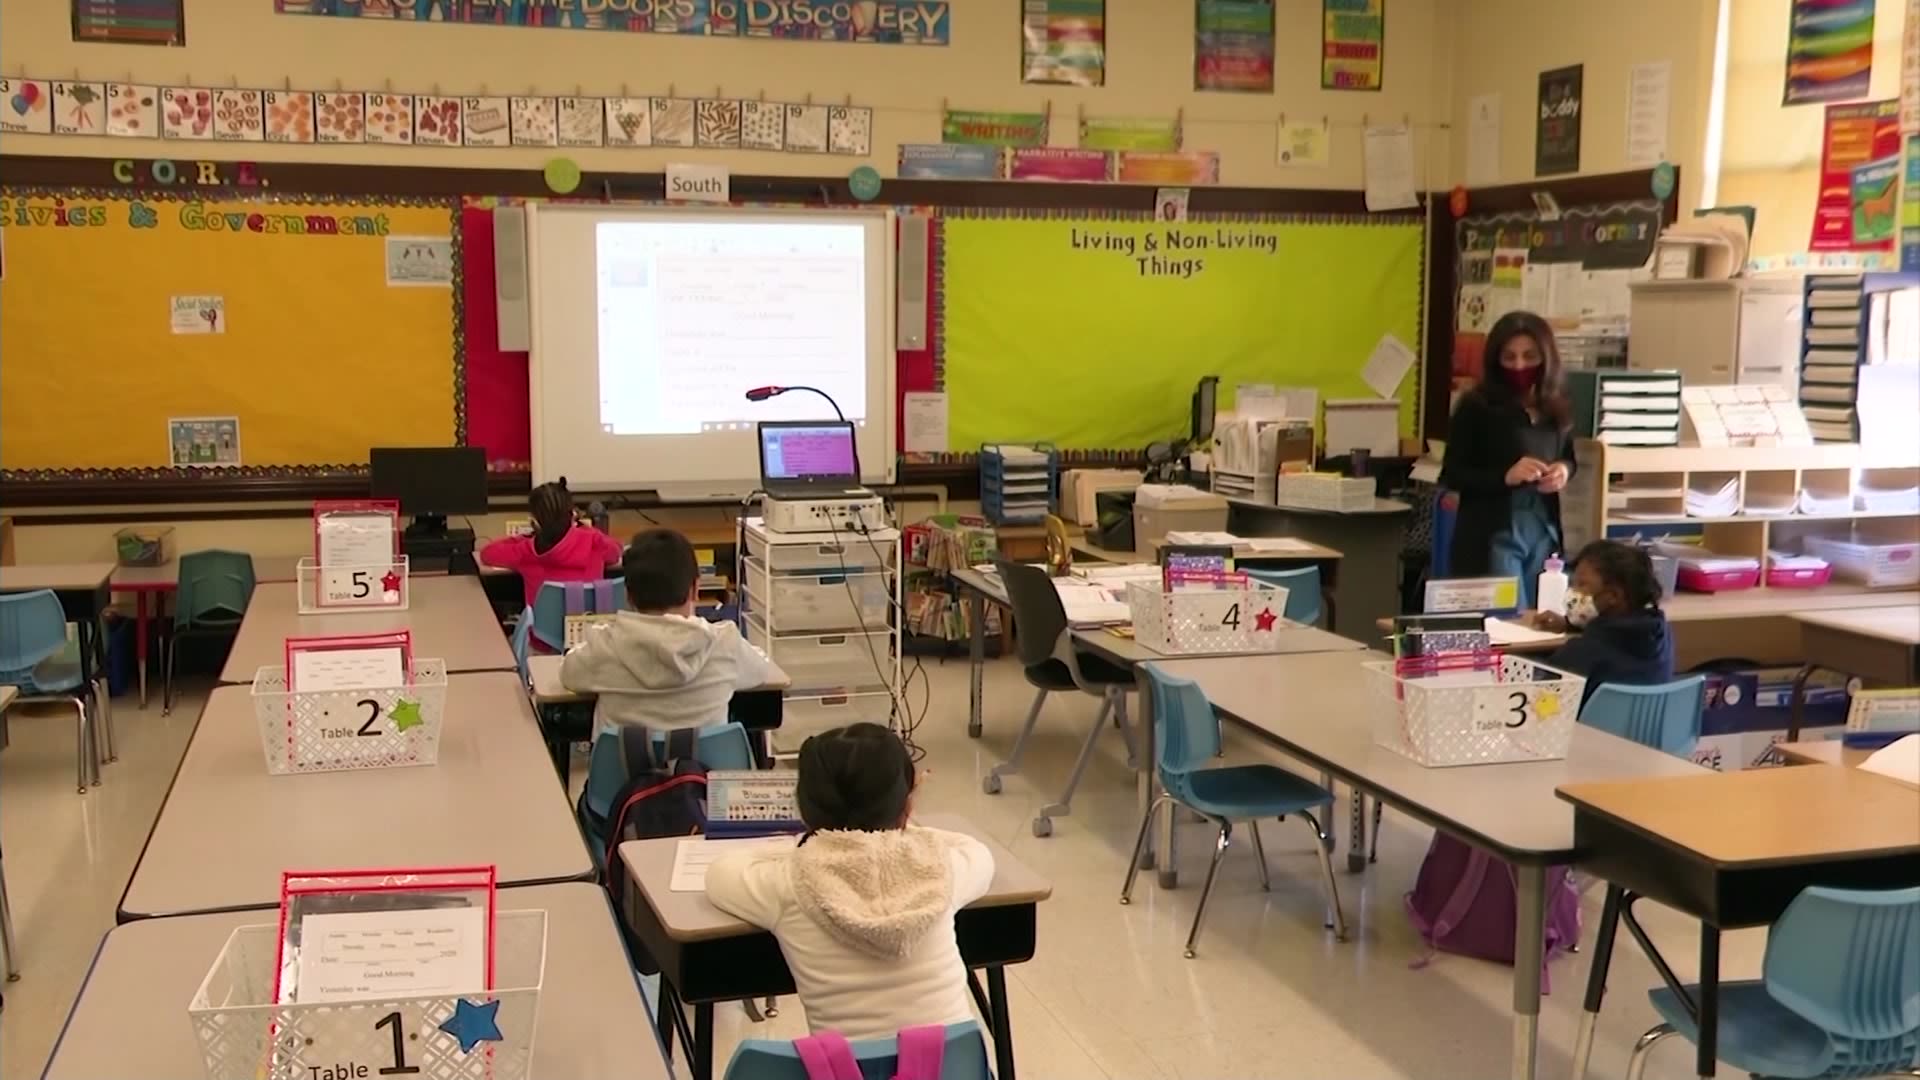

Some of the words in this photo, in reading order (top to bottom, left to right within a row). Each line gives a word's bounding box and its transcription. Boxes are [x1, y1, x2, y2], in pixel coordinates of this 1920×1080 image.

[0, 81, 9, 93] 3
[55, 84, 64, 96] 4
[109, 86, 118, 97] 5
[164, 89, 173, 101] 6
[215, 91, 224, 103] 7
[266, 92, 275, 104] 8
[318, 93, 326, 105] 9
[370, 95, 383, 106] 10
[418, 98, 431, 108] 11
[466, 99, 480, 110] 12
[515, 100, 528, 110] 13
[562, 100, 575, 110] 14
[610, 100, 622, 110] 15
[655, 101, 667, 111] 16
[745, 103, 758, 113] 18
[790, 107, 802, 117] 19
[832, 109, 847, 120] 20
[57, 125, 78, 133] Four
[960, 123, 1035, 139] WRITING
[672, 176, 722, 193] South
[129, 202, 158, 228] &
[179, 201, 390, 235] Government
[1072, 228, 1135, 256] Living
[1144, 232, 1158, 251] &
[1166, 230, 1278, 254] Non-Living
[1136, 256, 1203, 278] Things
[352, 571, 369, 598] 5
[1221, 602, 1241, 631] 4
[1476, 720, 1502, 730] Table
[1505, 691, 1528, 728] 3
[320, 728, 354, 739] Table
[357, 699, 382, 736] 2
[308, 1062, 369, 1080] Table
[375, 1012, 420, 1075] 1
